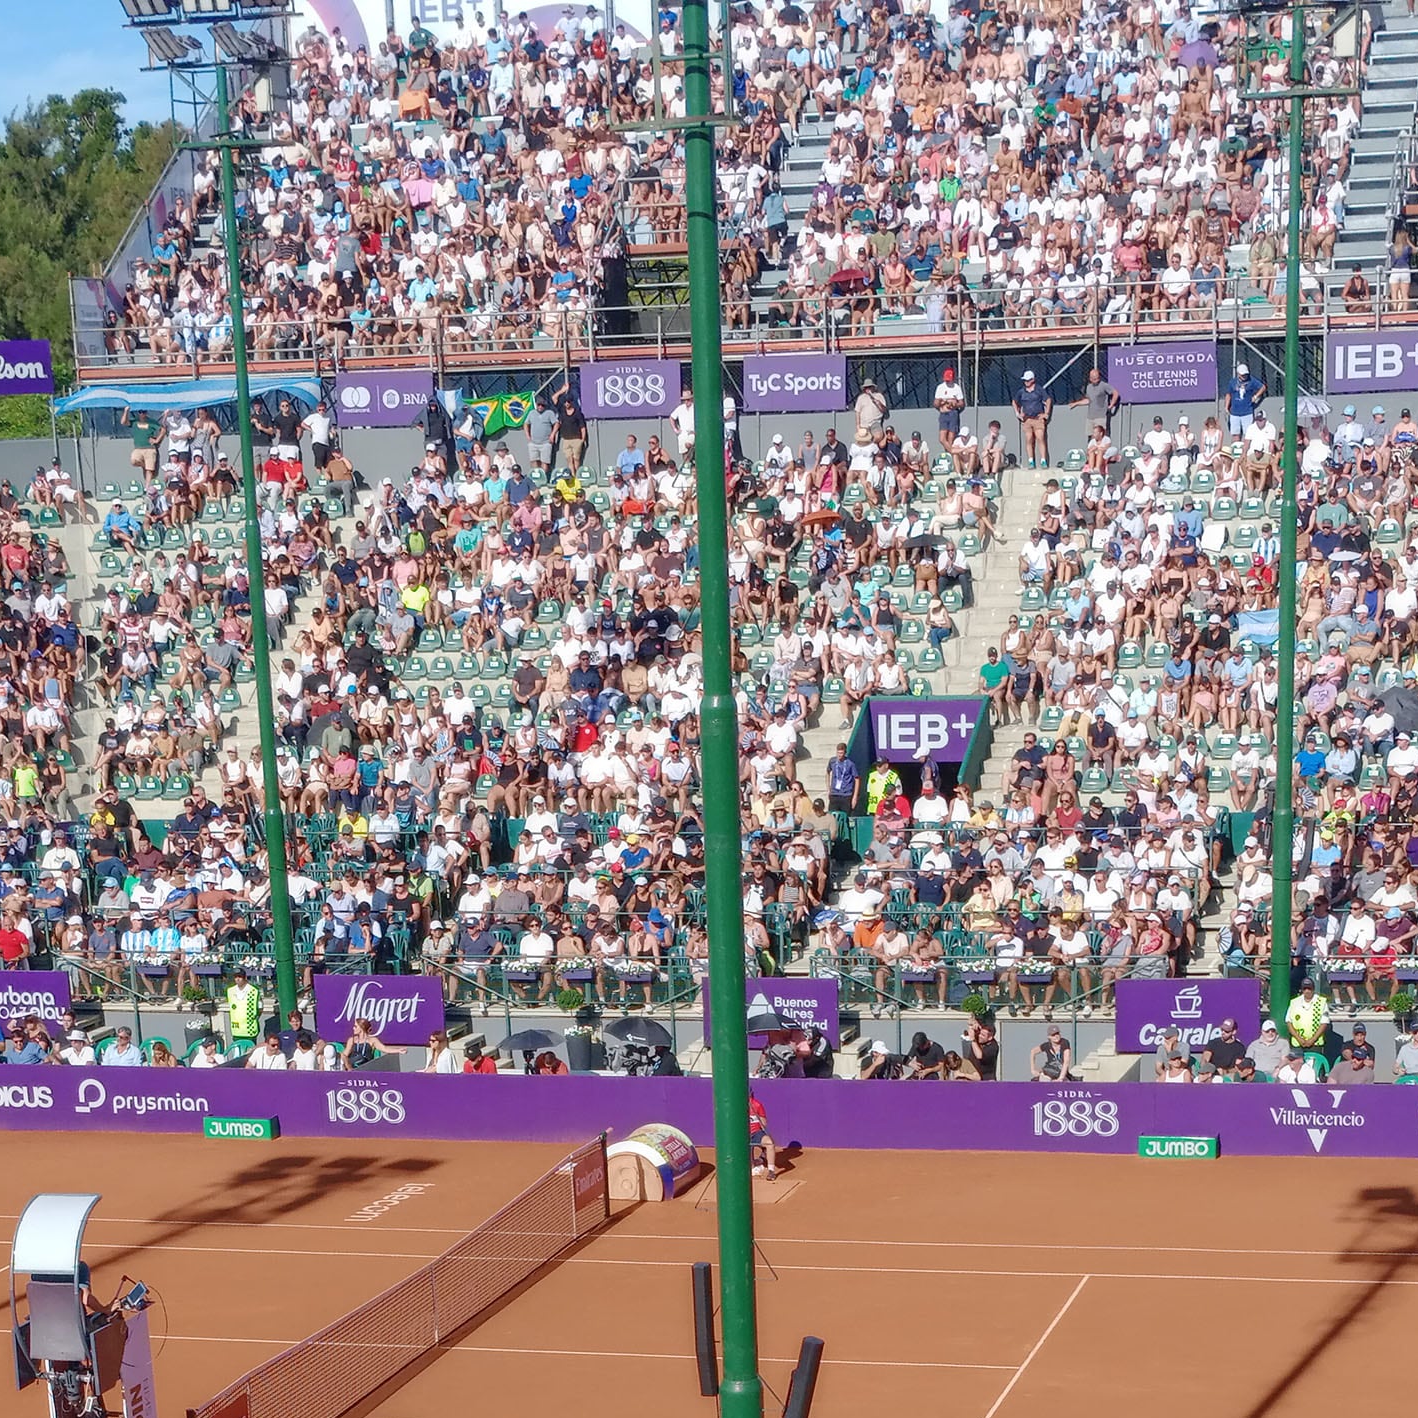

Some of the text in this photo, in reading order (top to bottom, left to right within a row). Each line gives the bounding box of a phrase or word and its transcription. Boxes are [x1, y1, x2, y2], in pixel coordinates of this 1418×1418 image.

[1115, 355, 1164, 366] MUSEO
[1132, 369, 1197, 380] THE TENNIS
[596, 374, 666, 407] 1888
[748, 372, 842, 396] TyC Sports
[1132, 378, 1198, 389] COLLECTION
[403, 393, 428, 405] BNA
[878, 713, 975, 749] IEB+
[334, 981, 425, 1038] Magret
[774, 997, 818, 1008] Buenos
[782, 1008, 814, 1019] Aires
[347, 1079, 379, 1088] SIDRA
[1057, 1090, 1092, 1098] SIDRA
[113, 1093, 209, 1114] prysmian
[326, 1089, 406, 1124] 1888
[1031, 1100, 1119, 1136] 1888
[1270, 1107, 1365, 1127] Villavicencio
[209, 1121, 264, 1138] JUMBO
[1145, 1141, 1208, 1155] JUMBO
[344, 1182, 436, 1222] telecom
